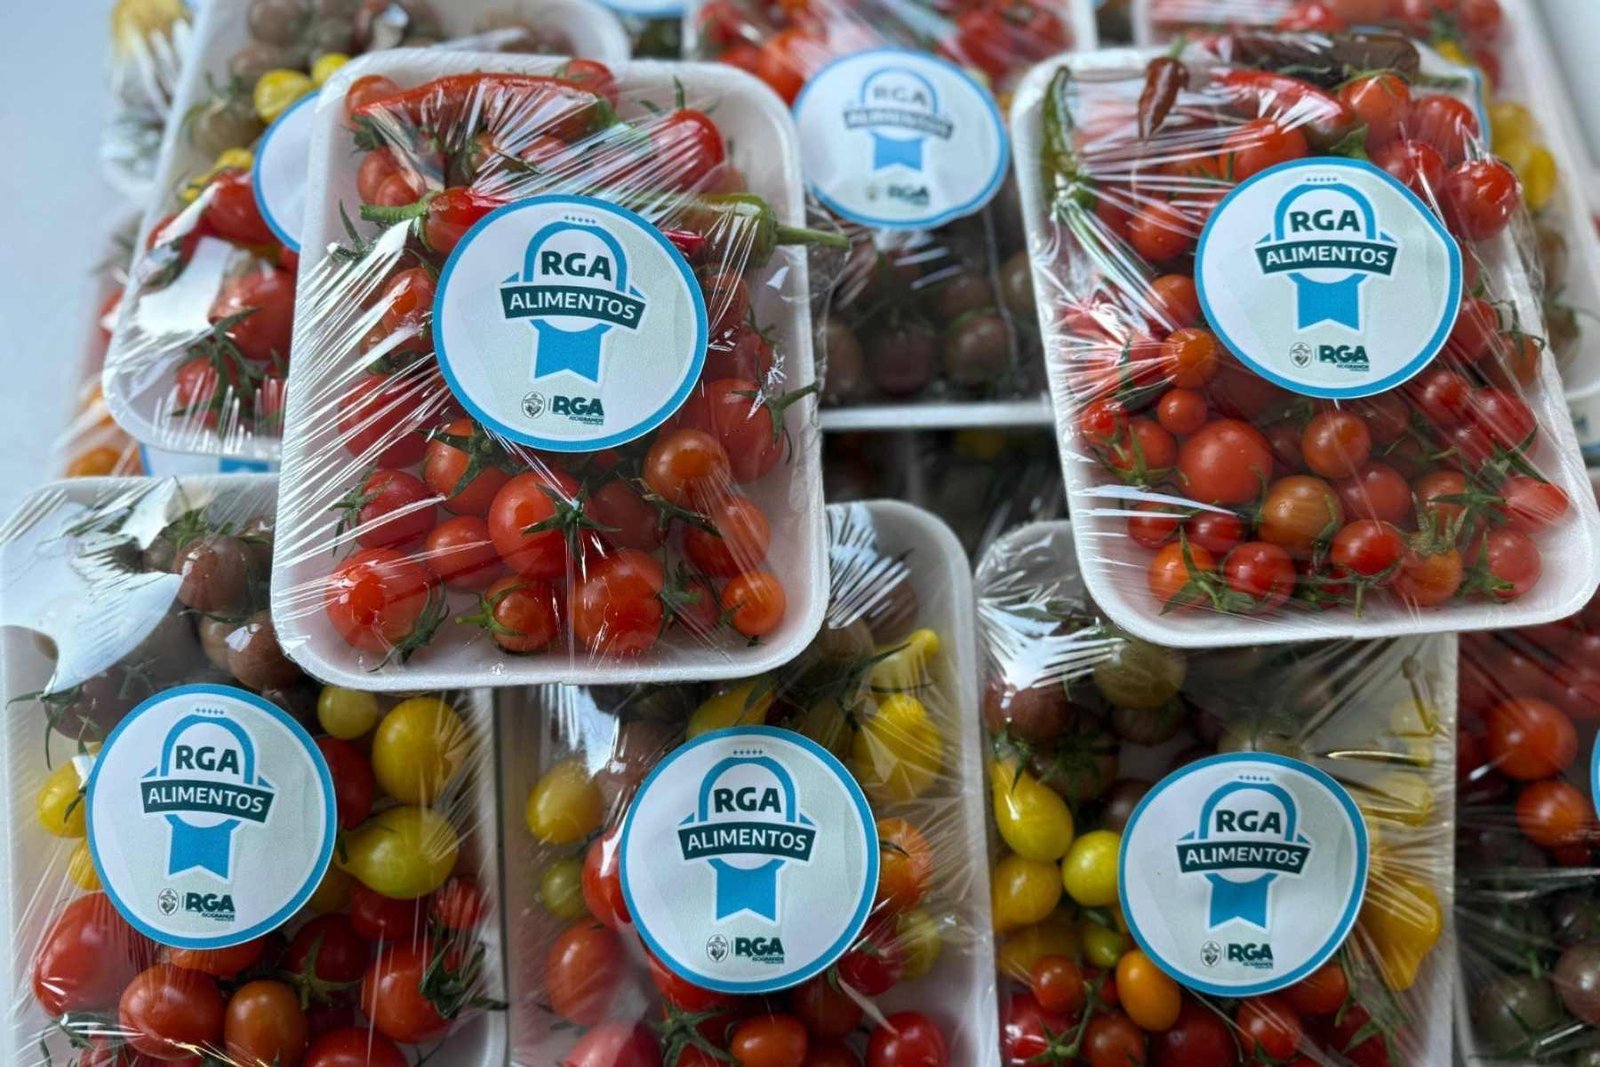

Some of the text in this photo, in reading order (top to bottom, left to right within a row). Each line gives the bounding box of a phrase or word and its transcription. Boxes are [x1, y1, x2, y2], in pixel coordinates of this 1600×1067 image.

[1289, 209, 1361, 233] RGA
[541, 250, 612, 281] RGA
[1265, 245, 1389, 267] ALIMENTOS
[509, 291, 637, 320] ALIMENTOS
[1318, 344, 1370, 364] RGA
[552, 395, 605, 417] RGA
[175, 744, 240, 775] RGA
[147, 786, 265, 813] ALIMENTOS
[713, 786, 782, 814] RGA
[1215, 809, 1282, 834] RGA
[687, 829, 808, 852] ALIMENTOS
[1184, 846, 1303, 867] ALIMENTOS
[185, 892, 236, 914] RGA
[734, 936, 785, 958] RGA
[1227, 943, 1274, 963] RGA
